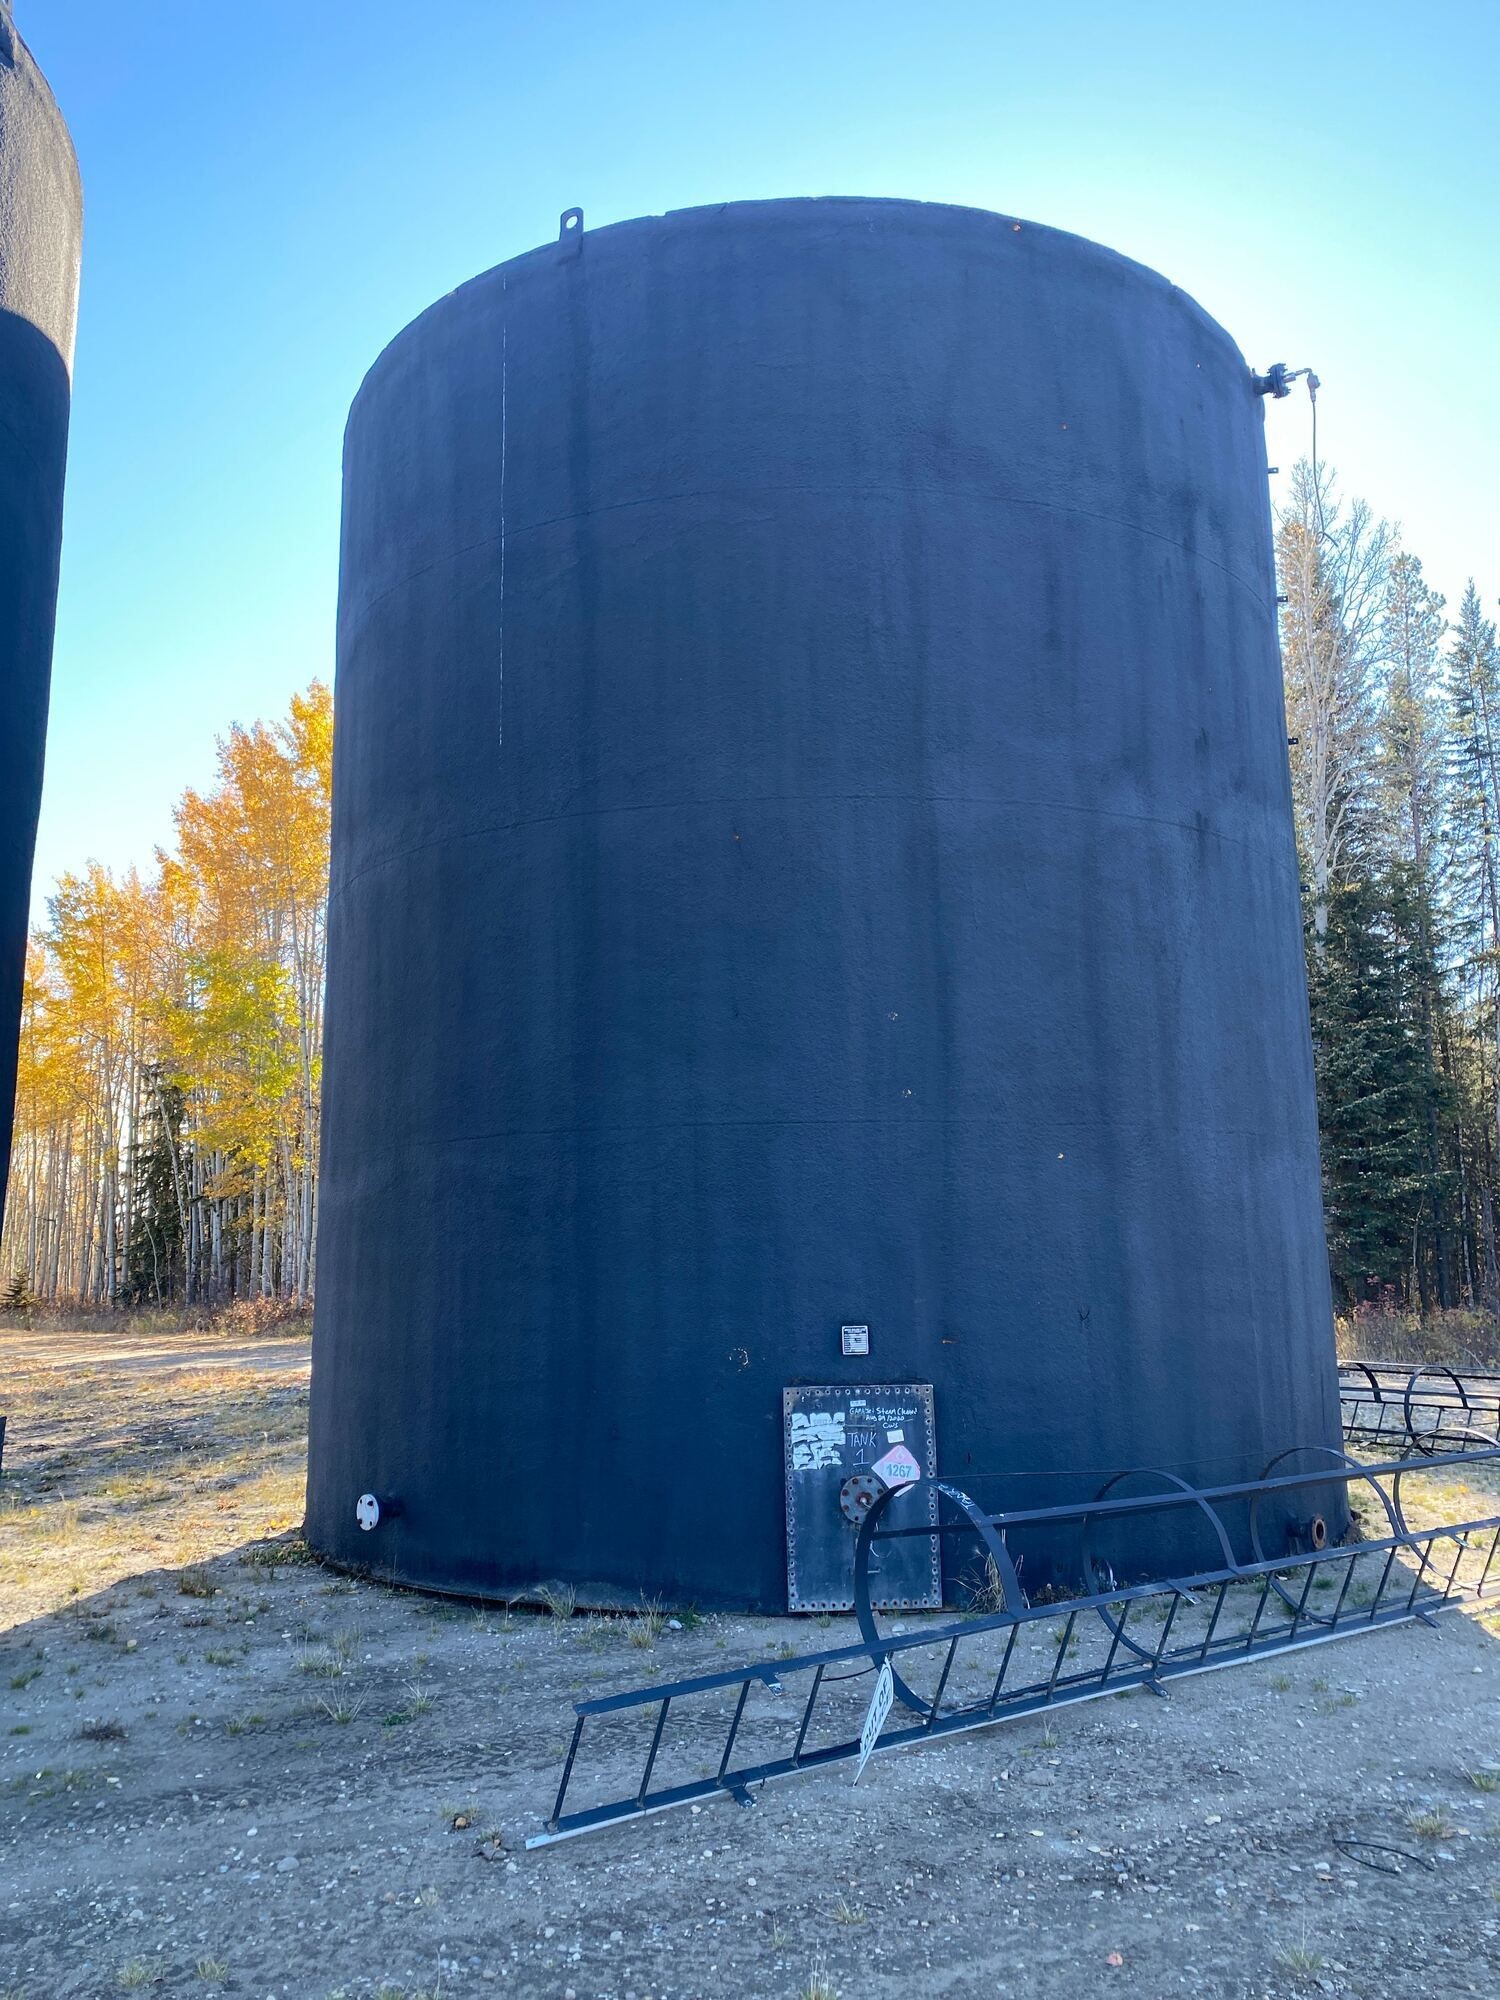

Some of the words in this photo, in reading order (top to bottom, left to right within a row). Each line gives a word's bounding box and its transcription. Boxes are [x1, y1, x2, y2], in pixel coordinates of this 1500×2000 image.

[847, 1431, 877, 1448] TANK
[853, 1448, 870, 1466] 1
[886, 1463, 912, 1478] 1267
